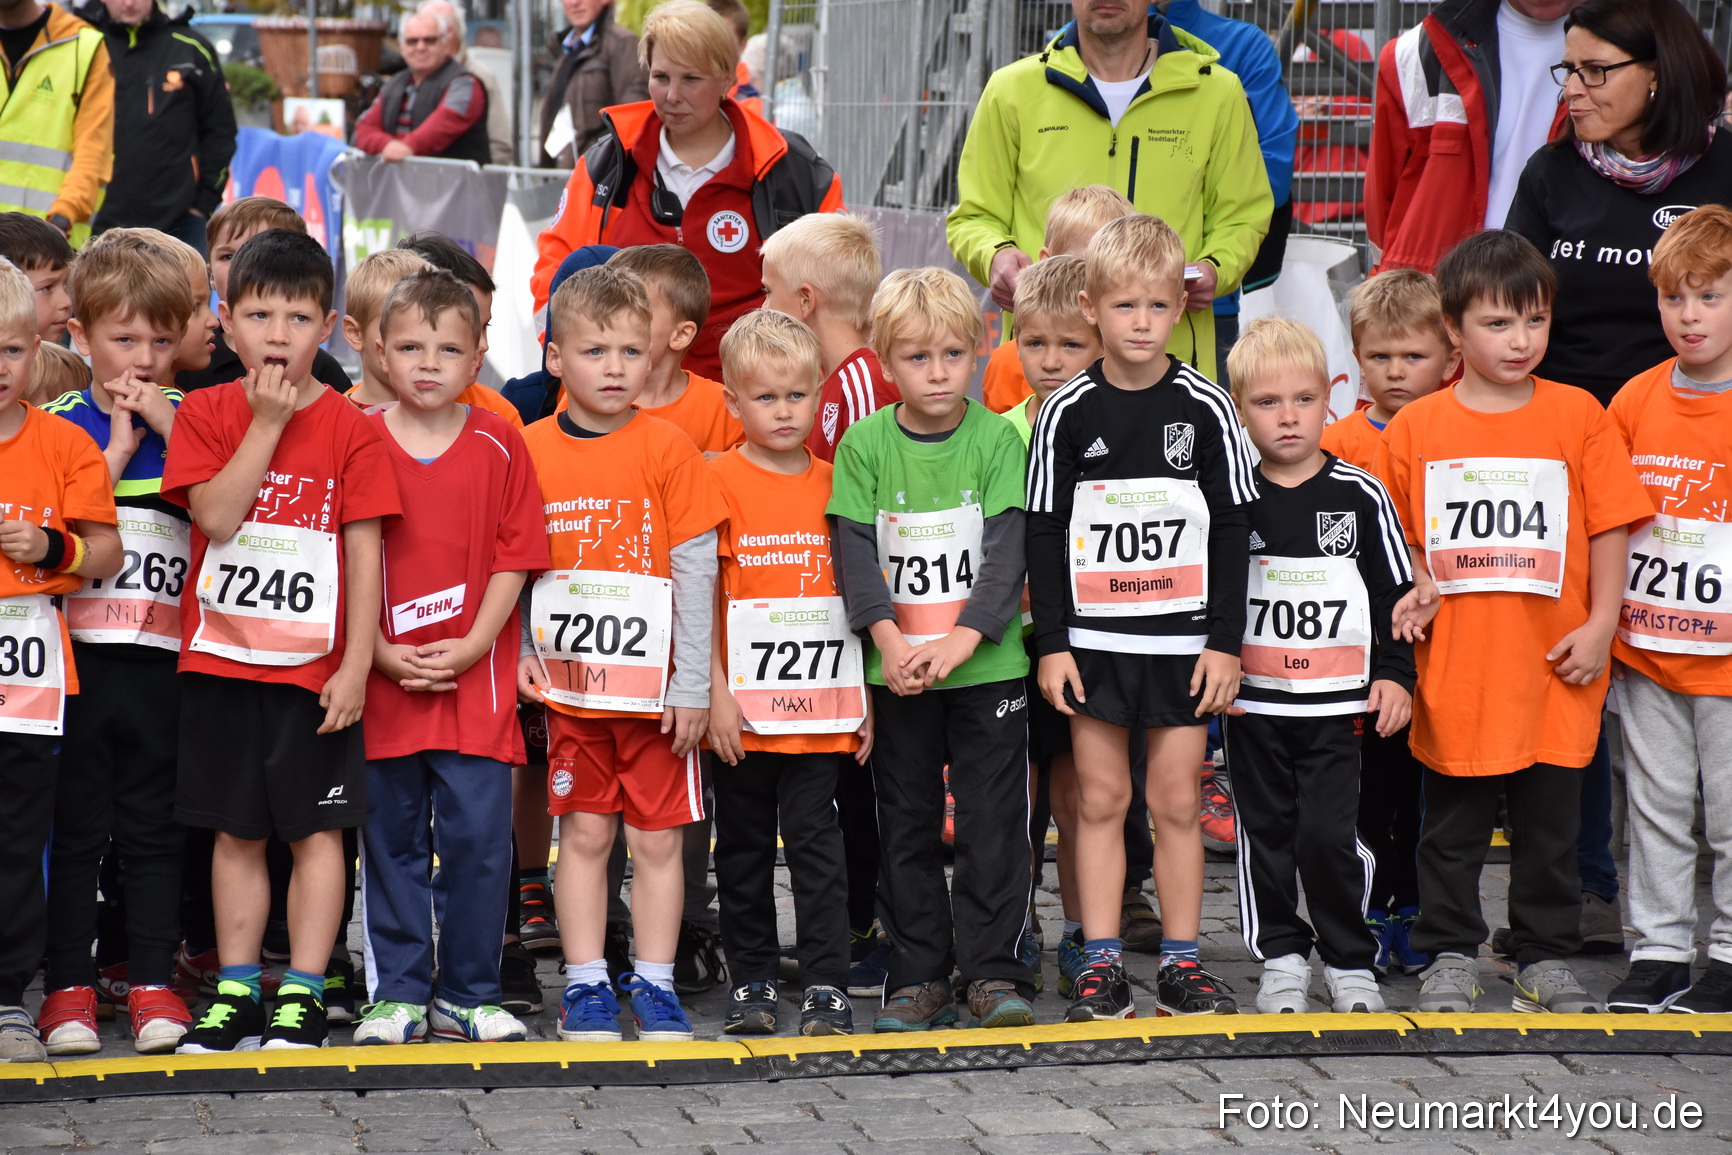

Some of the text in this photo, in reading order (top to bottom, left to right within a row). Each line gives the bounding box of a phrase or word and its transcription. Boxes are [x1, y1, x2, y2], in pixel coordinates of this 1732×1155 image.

[1147, 128, 1186, 136] Neumarkter
[1147, 136, 1178, 144] Stadtlauf
[1084, 447, 1110, 458] adidas
[1478, 470, 1529, 482] BOCK
[1120, 490, 1169, 504] BOCK
[1445, 499, 1548, 540] 7004
[126, 520, 174, 537] BOCK
[909, 522, 956, 537] BOCK
[1661, 527, 1705, 544] BOCK
[248, 535, 298, 551] BOCK
[738, 531, 825, 548] Neumarkter
[1090, 519, 1187, 563] 7057
[737, 550, 811, 567] Stadtlauf
[1456, 553, 1536, 569] Maximilian
[92, 549, 189, 597] 263
[888, 549, 974, 596] 7314
[1279, 570, 1327, 582] BOCK
[1629, 552, 1722, 604] 7216
[217, 563, 315, 613] 7246
[581, 584, 630, 597] BOCK
[1109, 575, 1173, 595] Benjamin
[417, 597, 453, 619] DEHN
[784, 609, 829, 622] BOCK
[1249, 598, 1347, 640] 7087
[1620, 605, 1718, 635] CHRISTOPH
[549, 613, 648, 657] 7202
[0, 635, 46, 678] 30
[751, 639, 845, 680] 7277
[1284, 654, 1310, 670] Leo
[561, 659, 606, 692] TIM
[771, 696, 813, 713] MAXI
